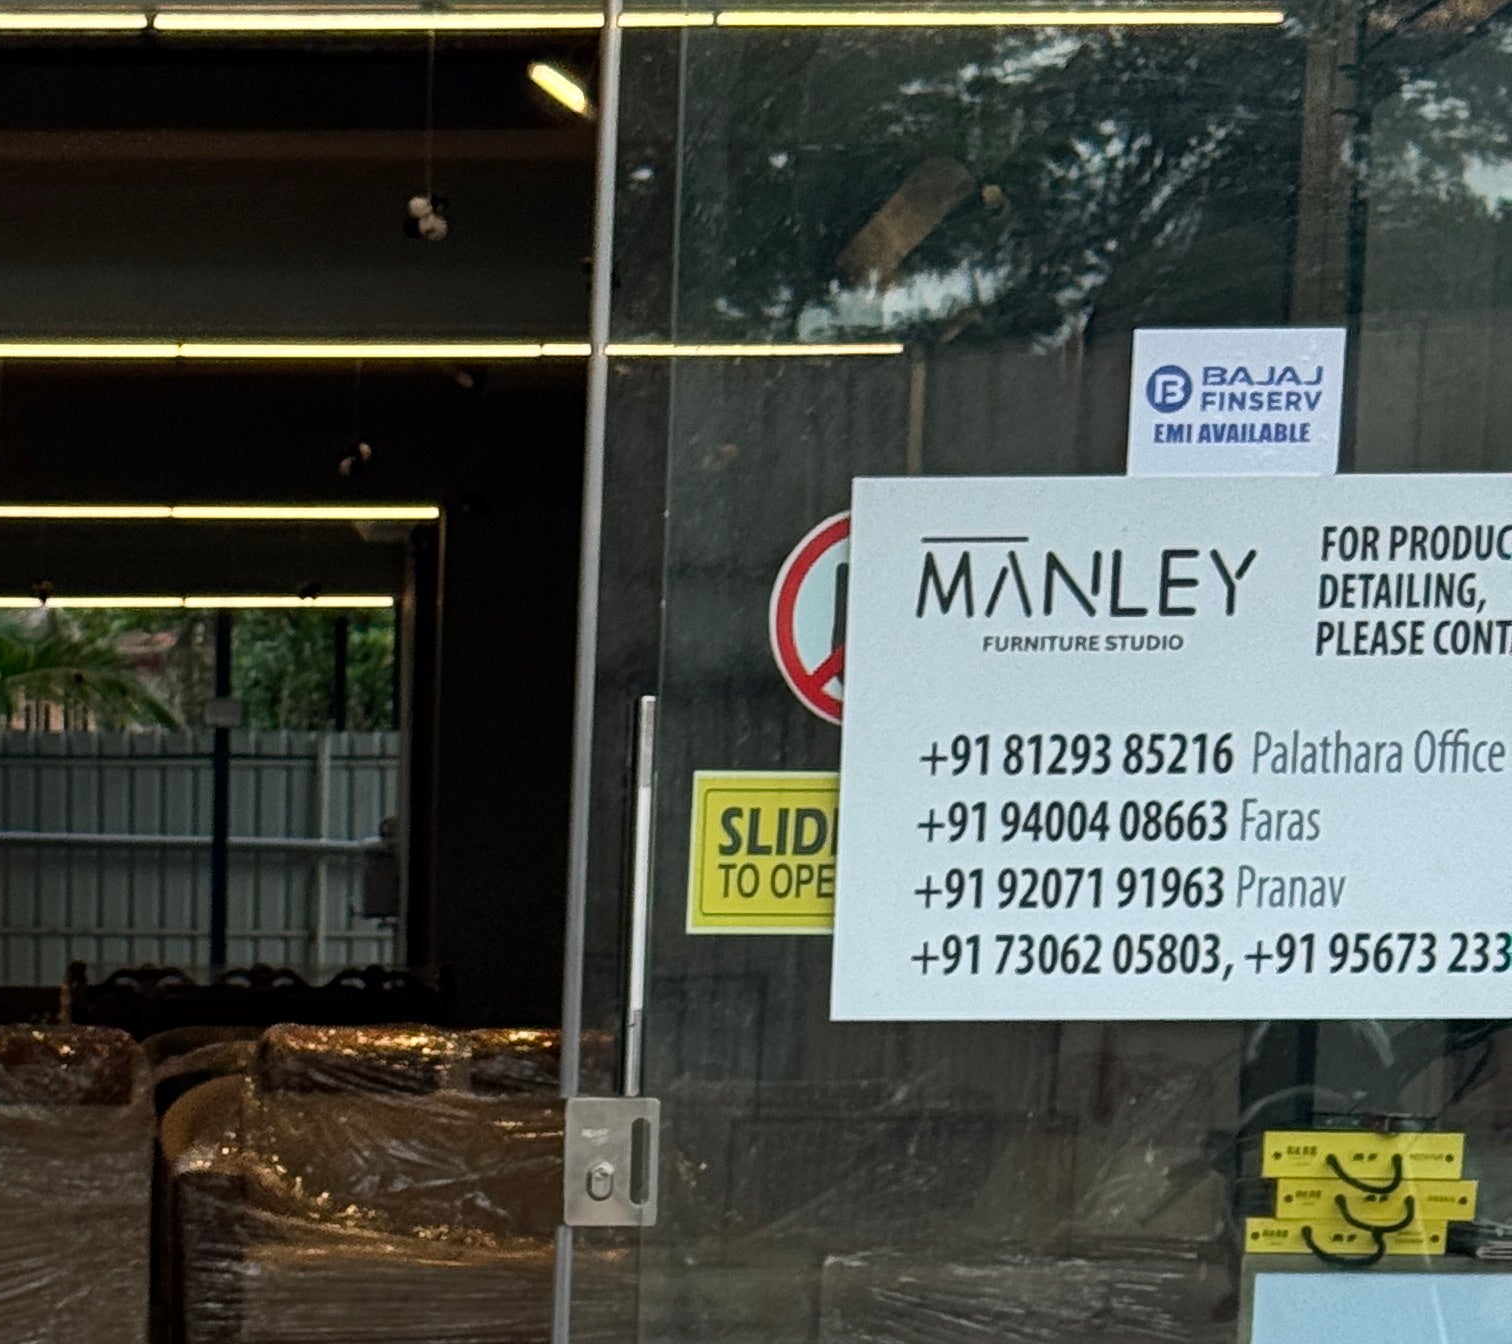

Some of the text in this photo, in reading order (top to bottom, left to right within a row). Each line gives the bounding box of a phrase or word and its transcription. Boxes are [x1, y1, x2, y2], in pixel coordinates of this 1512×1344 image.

[1201, 365, 1324, 386] BAJAJ
[1200, 391, 1322, 412] FINSERV
[1153, 422, 1311, 444] EMI AVAILABLE
[1321, 524, 1512, 562] FOR PRODUC
[1318, 572, 1487, 613] DETAILING,
[982, 634, 1184, 652] FURNITURE STUDIO
[1316, 619, 1512, 656] PLEASE CONT
[919, 728, 1505, 776] +91 81293 85216 Palathara Office
[917, 798, 1321, 842] +91 94004 08663 Faras
[718, 862, 835, 899] TO OPE
[914, 865, 1347, 909] +91 92071 91963 Pranav
[911, 931, 1512, 981] +91 73062 05803, +91 95673 233
